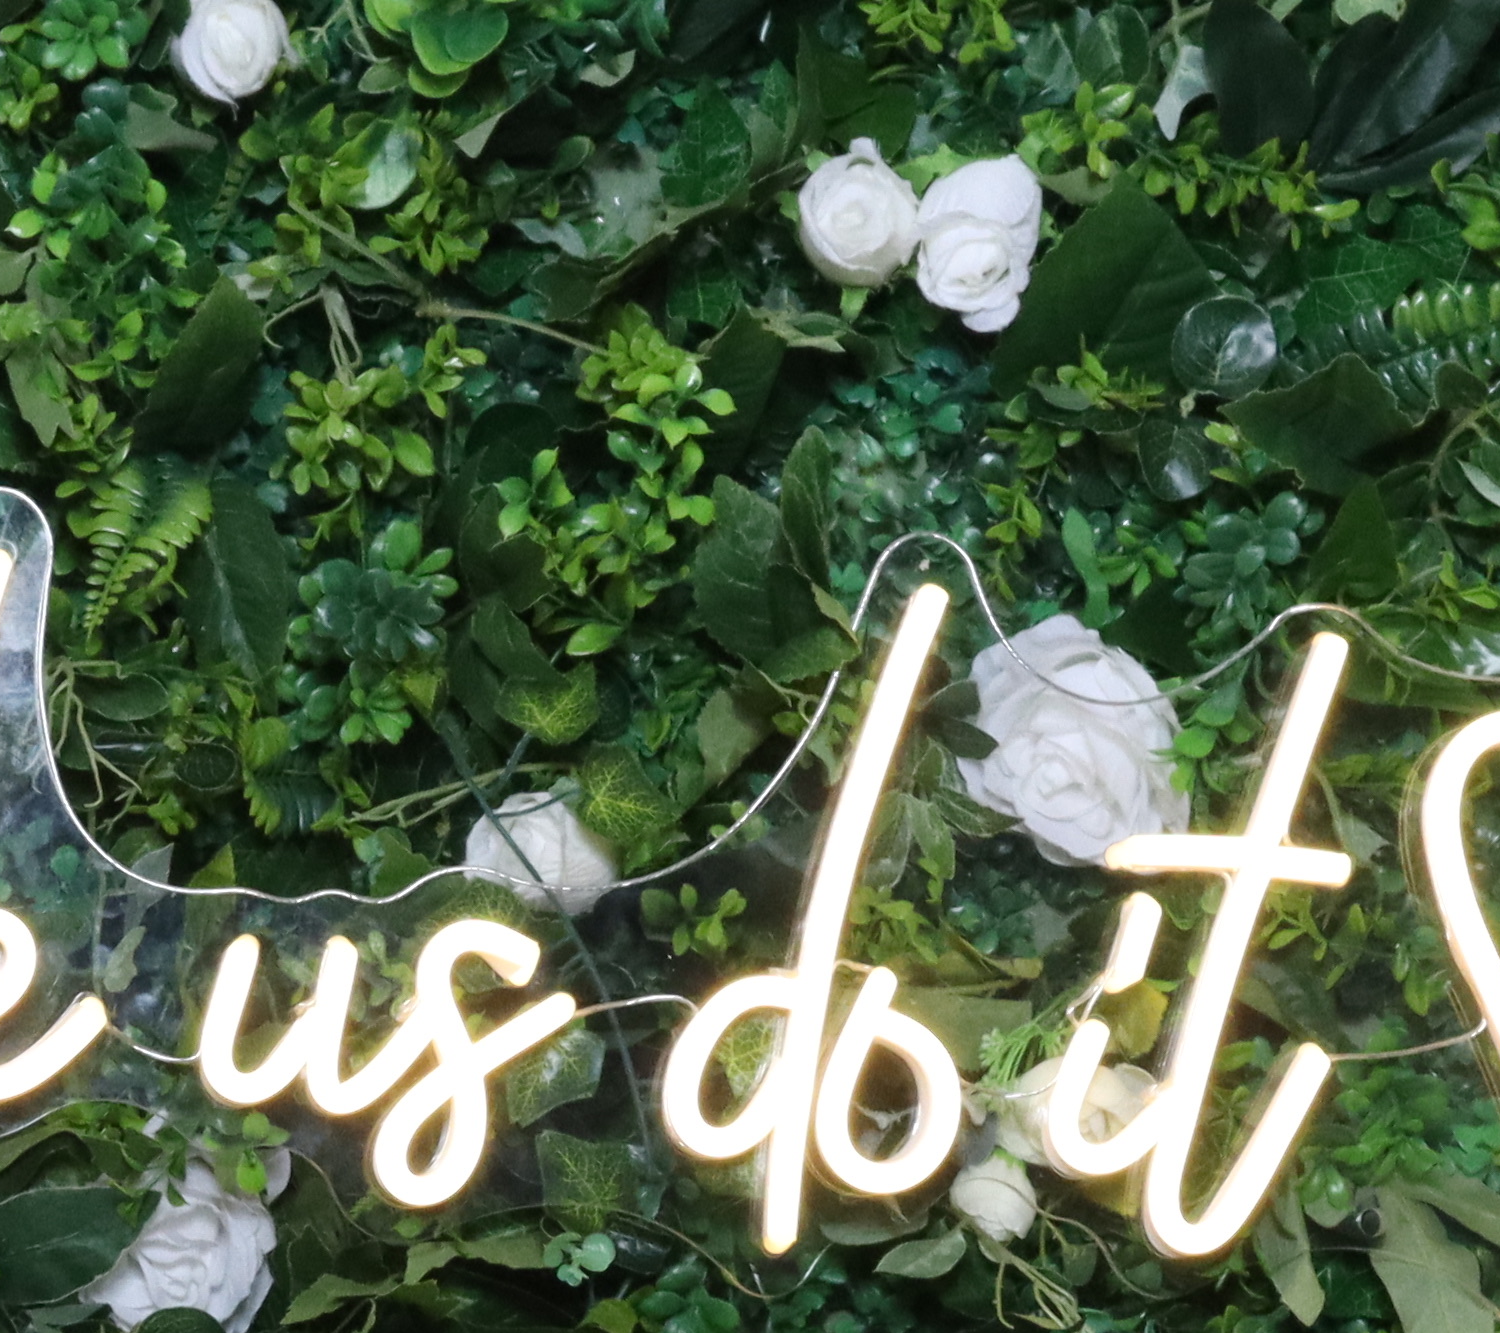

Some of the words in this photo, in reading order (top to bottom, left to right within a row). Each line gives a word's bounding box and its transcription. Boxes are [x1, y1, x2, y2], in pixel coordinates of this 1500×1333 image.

[197, 917, 578, 1209] us
[661, 582, 962, 1256] do
[1040, 630, 1353, 1259] it
